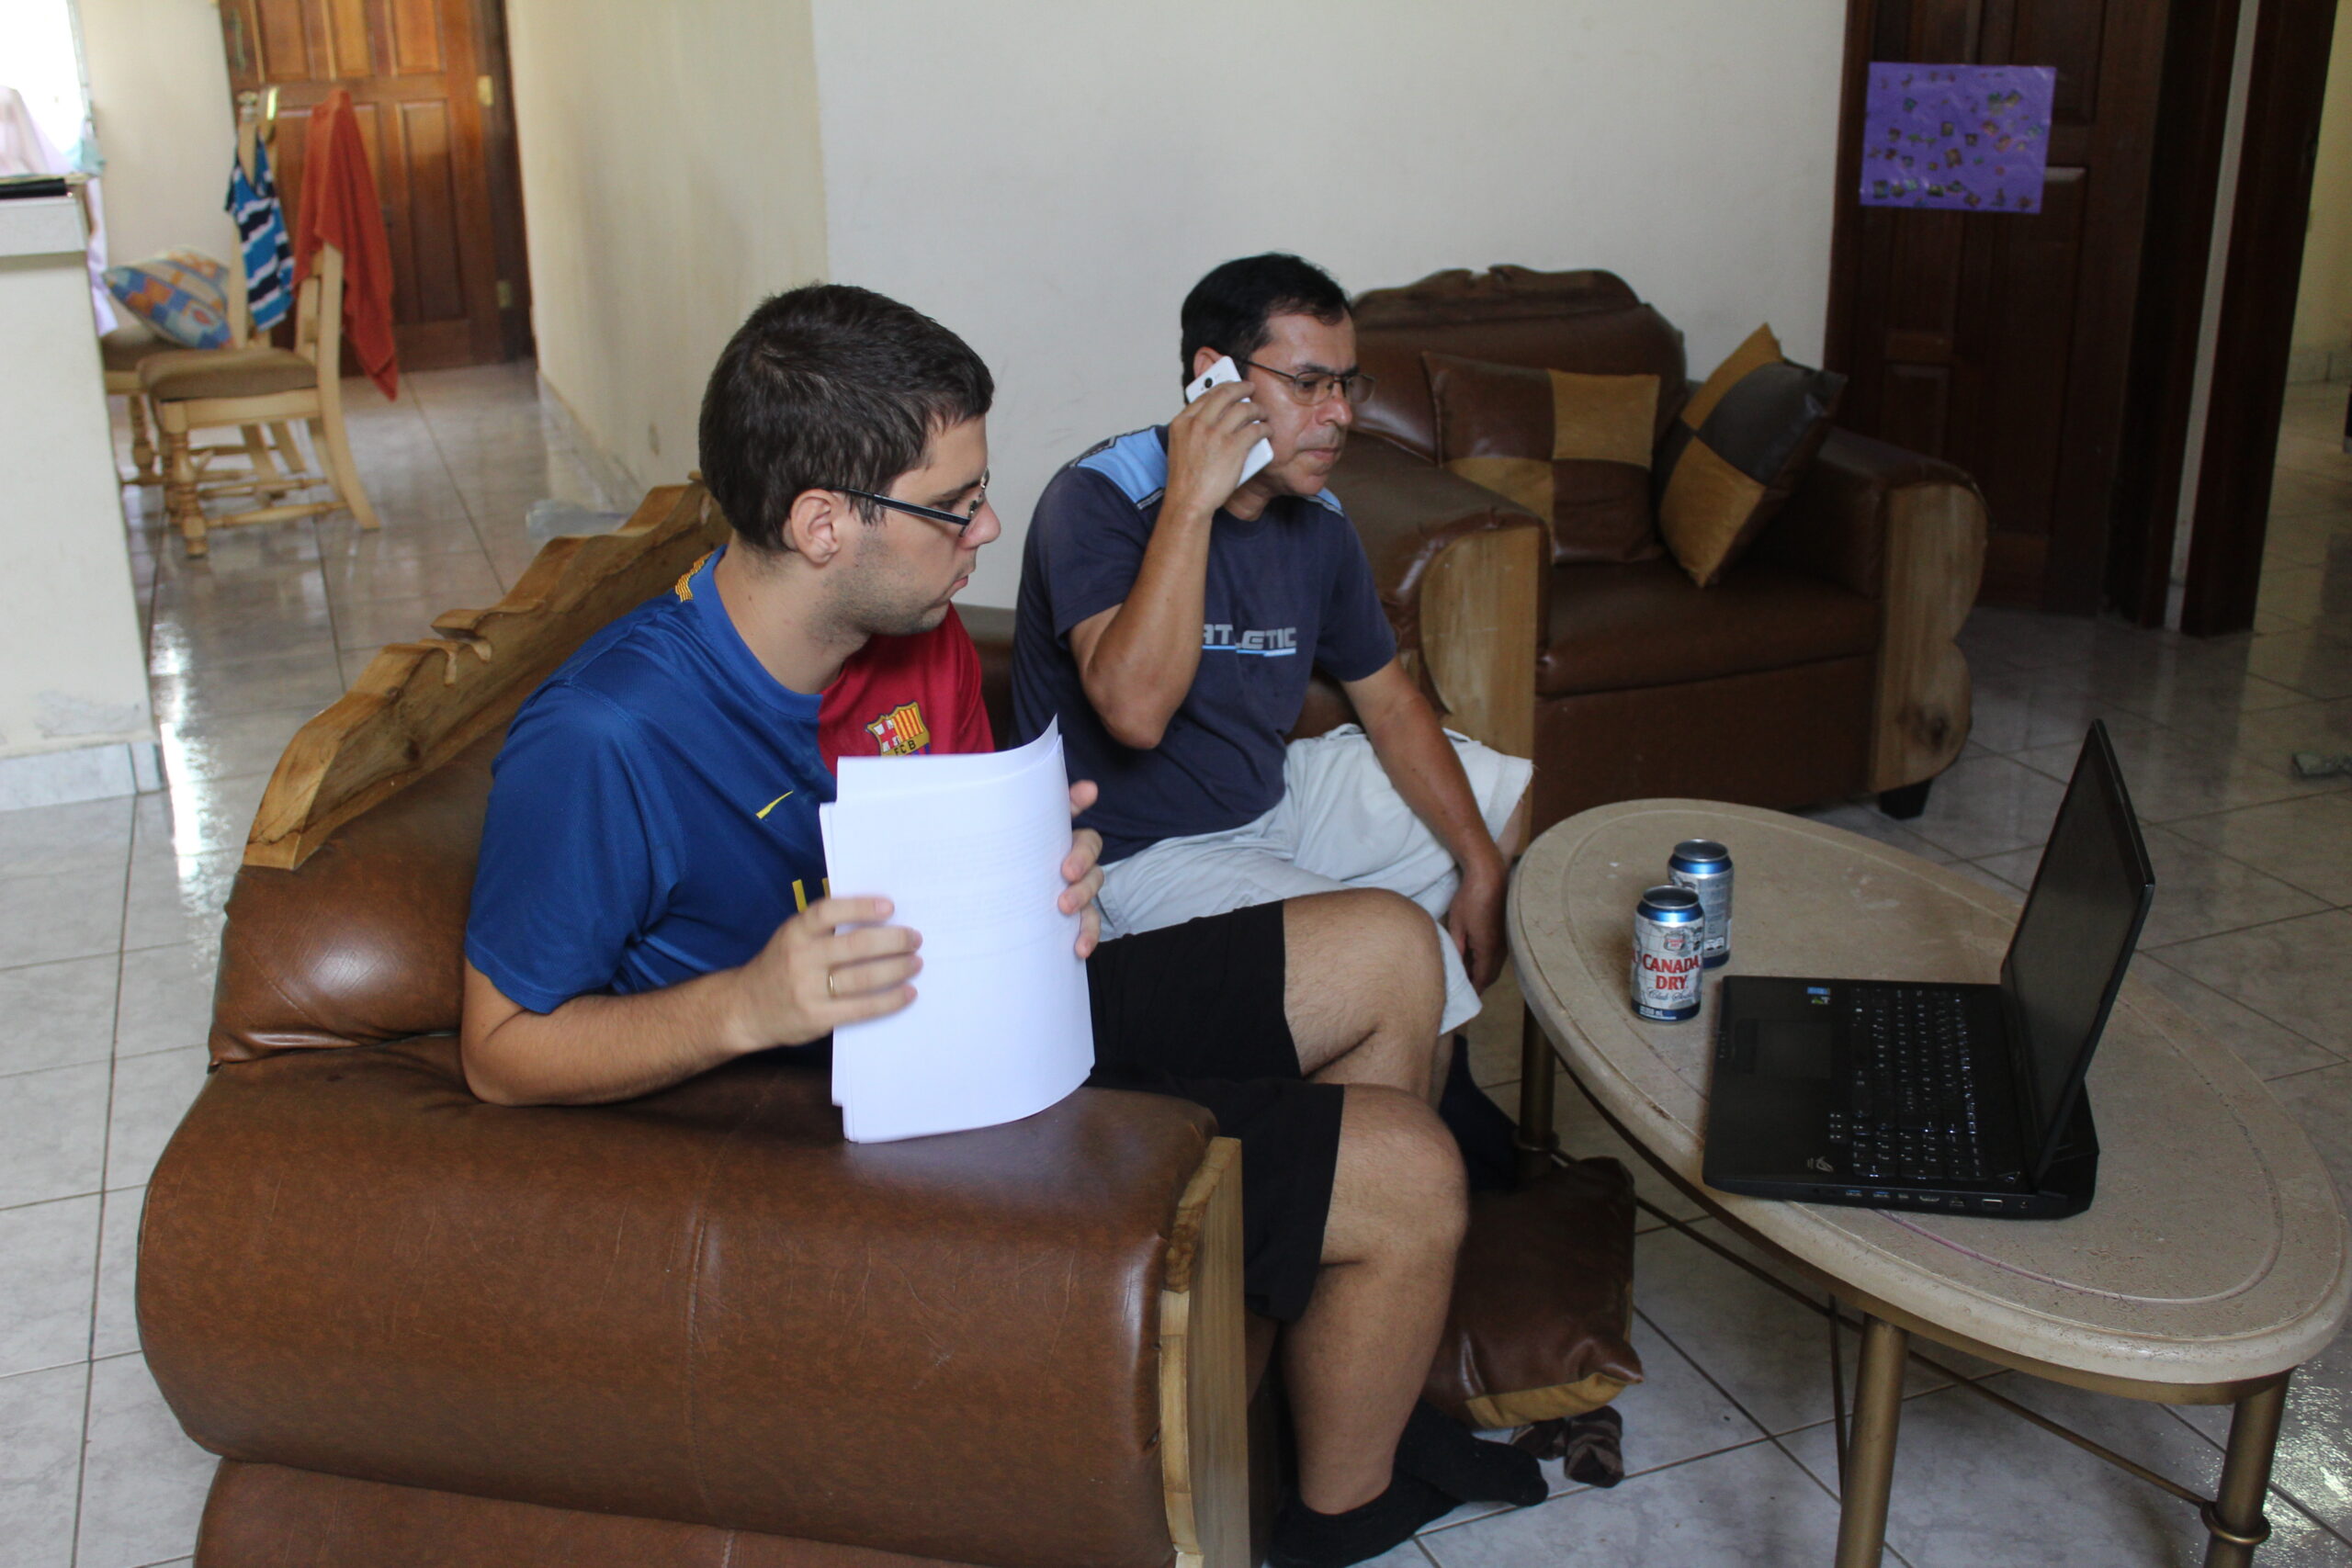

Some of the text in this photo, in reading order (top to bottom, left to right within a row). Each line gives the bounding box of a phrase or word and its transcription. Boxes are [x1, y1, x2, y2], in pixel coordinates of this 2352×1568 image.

[1204, 624, 1296, 649] ATETIC
[1643, 953, 1700, 974] CANADA
[1656, 975, 1689, 990] DRY
